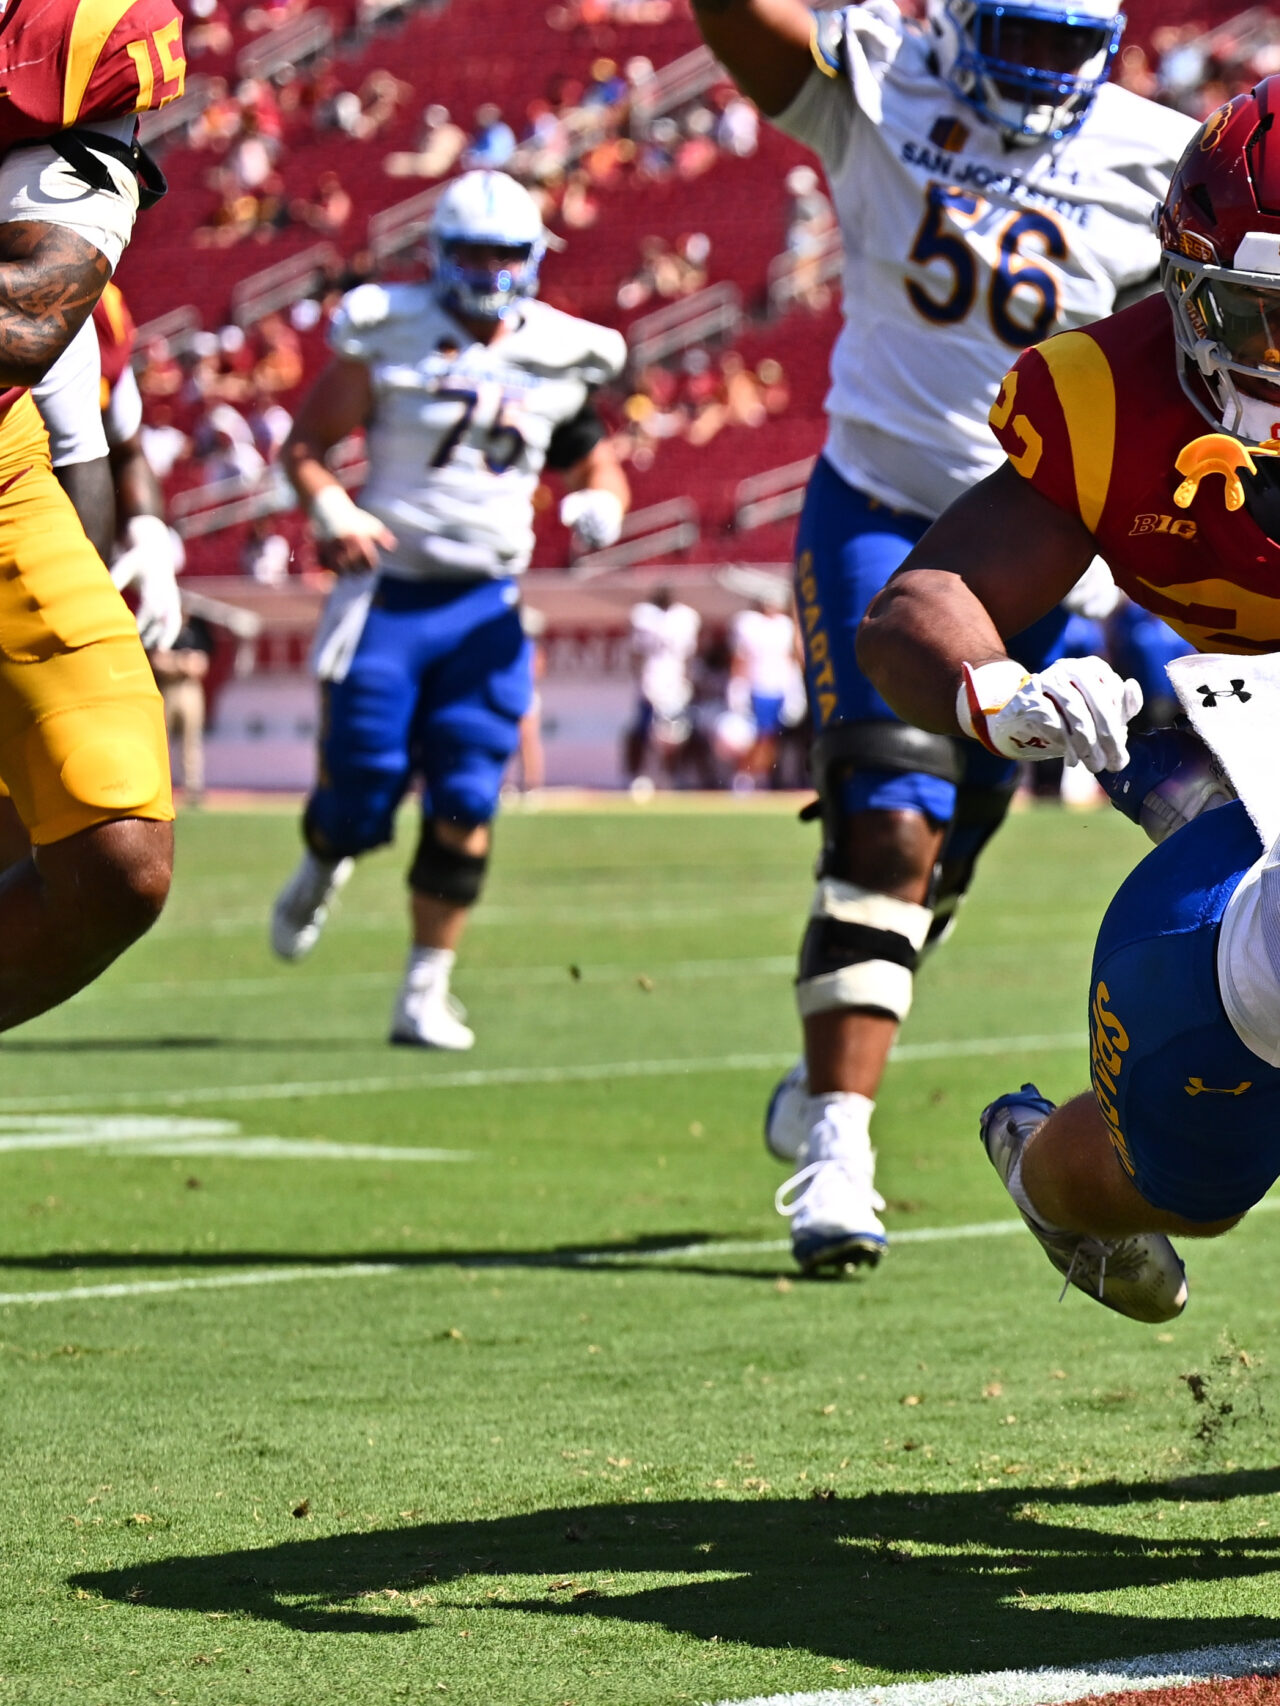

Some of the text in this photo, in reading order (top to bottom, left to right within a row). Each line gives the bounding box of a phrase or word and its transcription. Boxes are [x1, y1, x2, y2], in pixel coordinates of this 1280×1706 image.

[126, 17, 188, 113] 15
[902, 141, 953, 178] SAN
[903, 180, 1069, 348] 56
